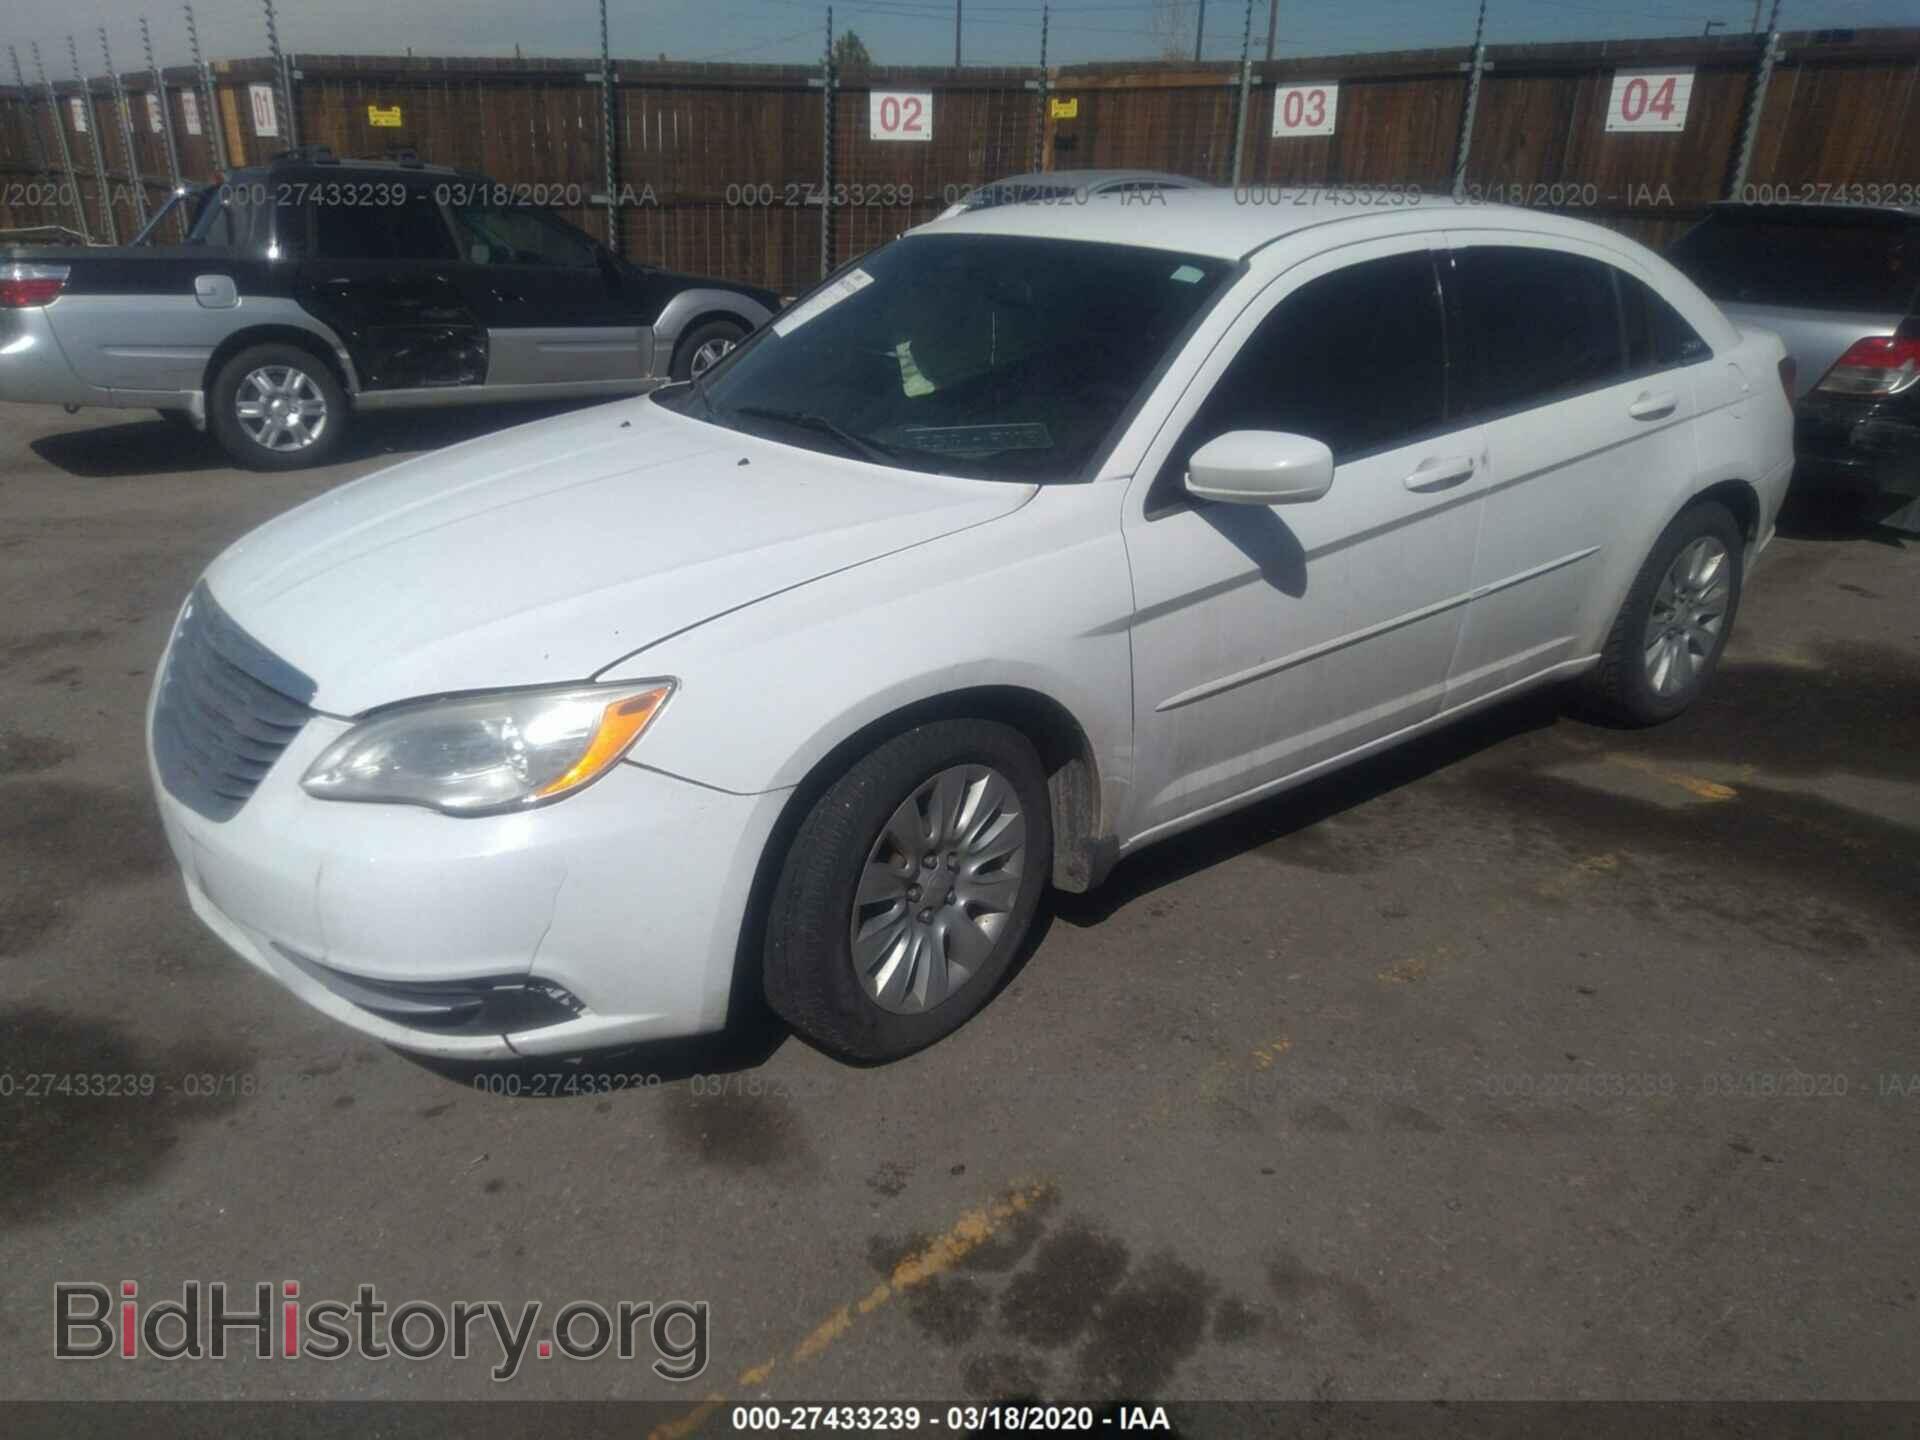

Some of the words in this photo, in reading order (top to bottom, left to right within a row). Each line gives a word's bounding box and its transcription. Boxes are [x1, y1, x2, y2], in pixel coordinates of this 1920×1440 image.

[880, 96, 922, 131] 02
[1284, 89, 1326, 128] 03
[1622, 77, 1677, 121] 04
